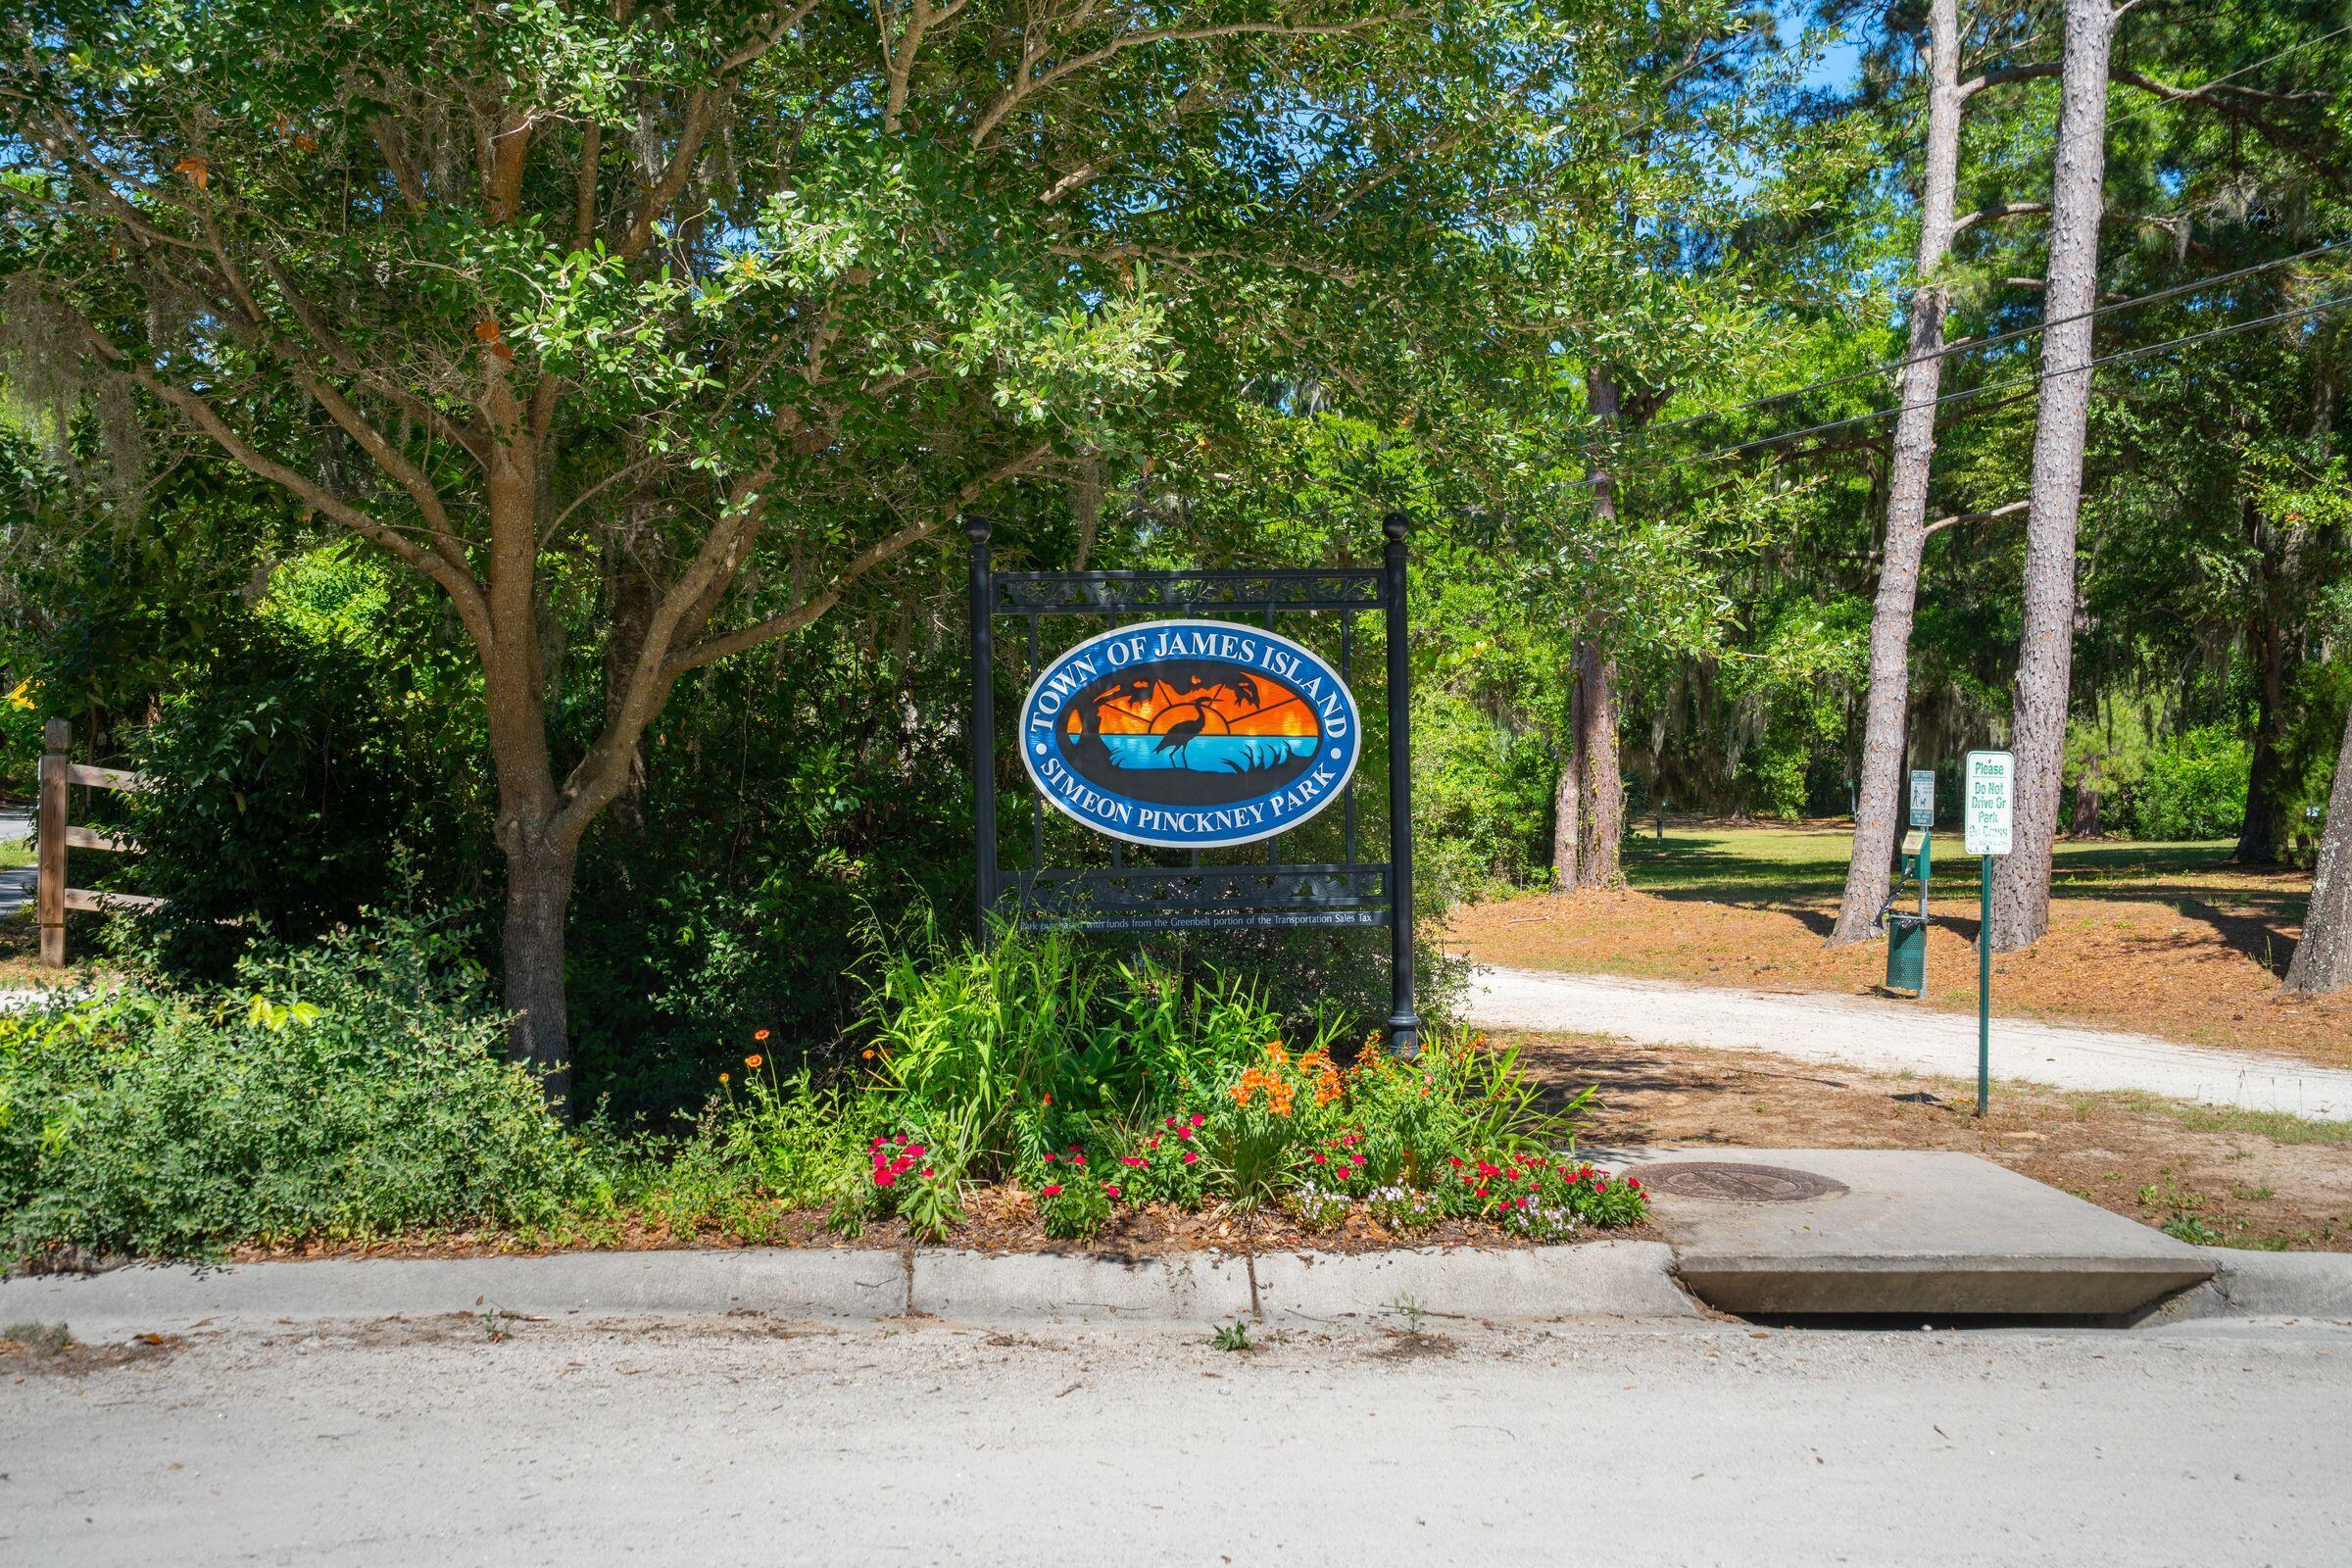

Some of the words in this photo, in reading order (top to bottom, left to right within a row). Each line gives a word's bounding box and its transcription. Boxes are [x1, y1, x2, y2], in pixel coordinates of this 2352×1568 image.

[1031, 653, 1098, 733] TOWN
[1106, 635, 1147, 666] OF
[1153, 632, 1256, 663] JAMES
[1259, 646, 1348, 737] ISLAND
[1975, 762, 2004, 775] Please
[1975, 781, 1985, 795] Do
[1988, 782, 2004, 795] Not
[1041, 758, 1132, 826] SIMEON
[1138, 803, 1266, 833] PINCKNEY
[1269, 762, 1337, 817] PARK
[1972, 796, 1993, 809] Drive
[1996, 796, 2006, 809] Or
[1979, 810, 1998, 823] Park
[1041, 921, 1083, 933] purasd
[1086, 919, 1105, 929] with
[1106, 918, 1129, 928] funds
[1132, 918, 1152, 928] from
[1154, 917, 1168, 927] the
[1170, 916, 1211, 927] Greenbelt
[1213, 916, 1244, 928] portion
[1247, 915, 1256, 925] of
[1257, 915, 1272, 925] the
[1274, 914, 1333, 926] Transportation
[1335, 913, 1356, 923] Sales
[1358, 912, 1372, 922] Tax
